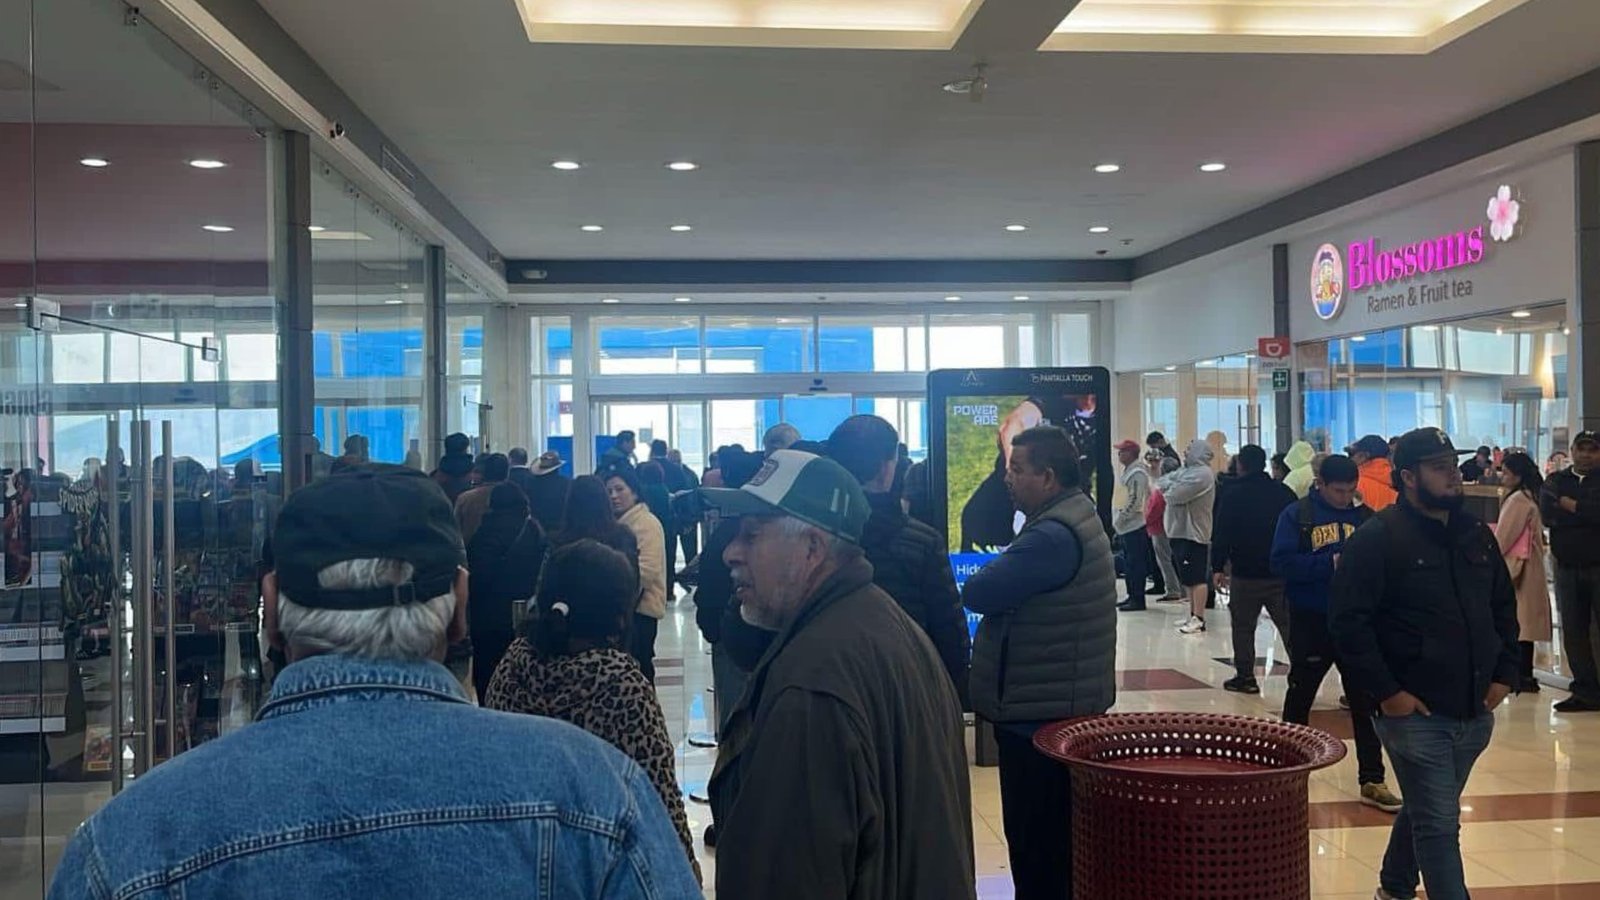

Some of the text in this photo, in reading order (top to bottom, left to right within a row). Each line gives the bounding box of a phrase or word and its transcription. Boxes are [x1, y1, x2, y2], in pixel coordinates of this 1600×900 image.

[1347, 224, 1485, 292] Blossoms
[1367, 278, 1473, 313] Ramen & Fruit tea
[1040, 374, 1093, 383] PANTALLA TOUCH
[953, 404, 998, 416] POWER
[973, 415, 999, 425] ADE
